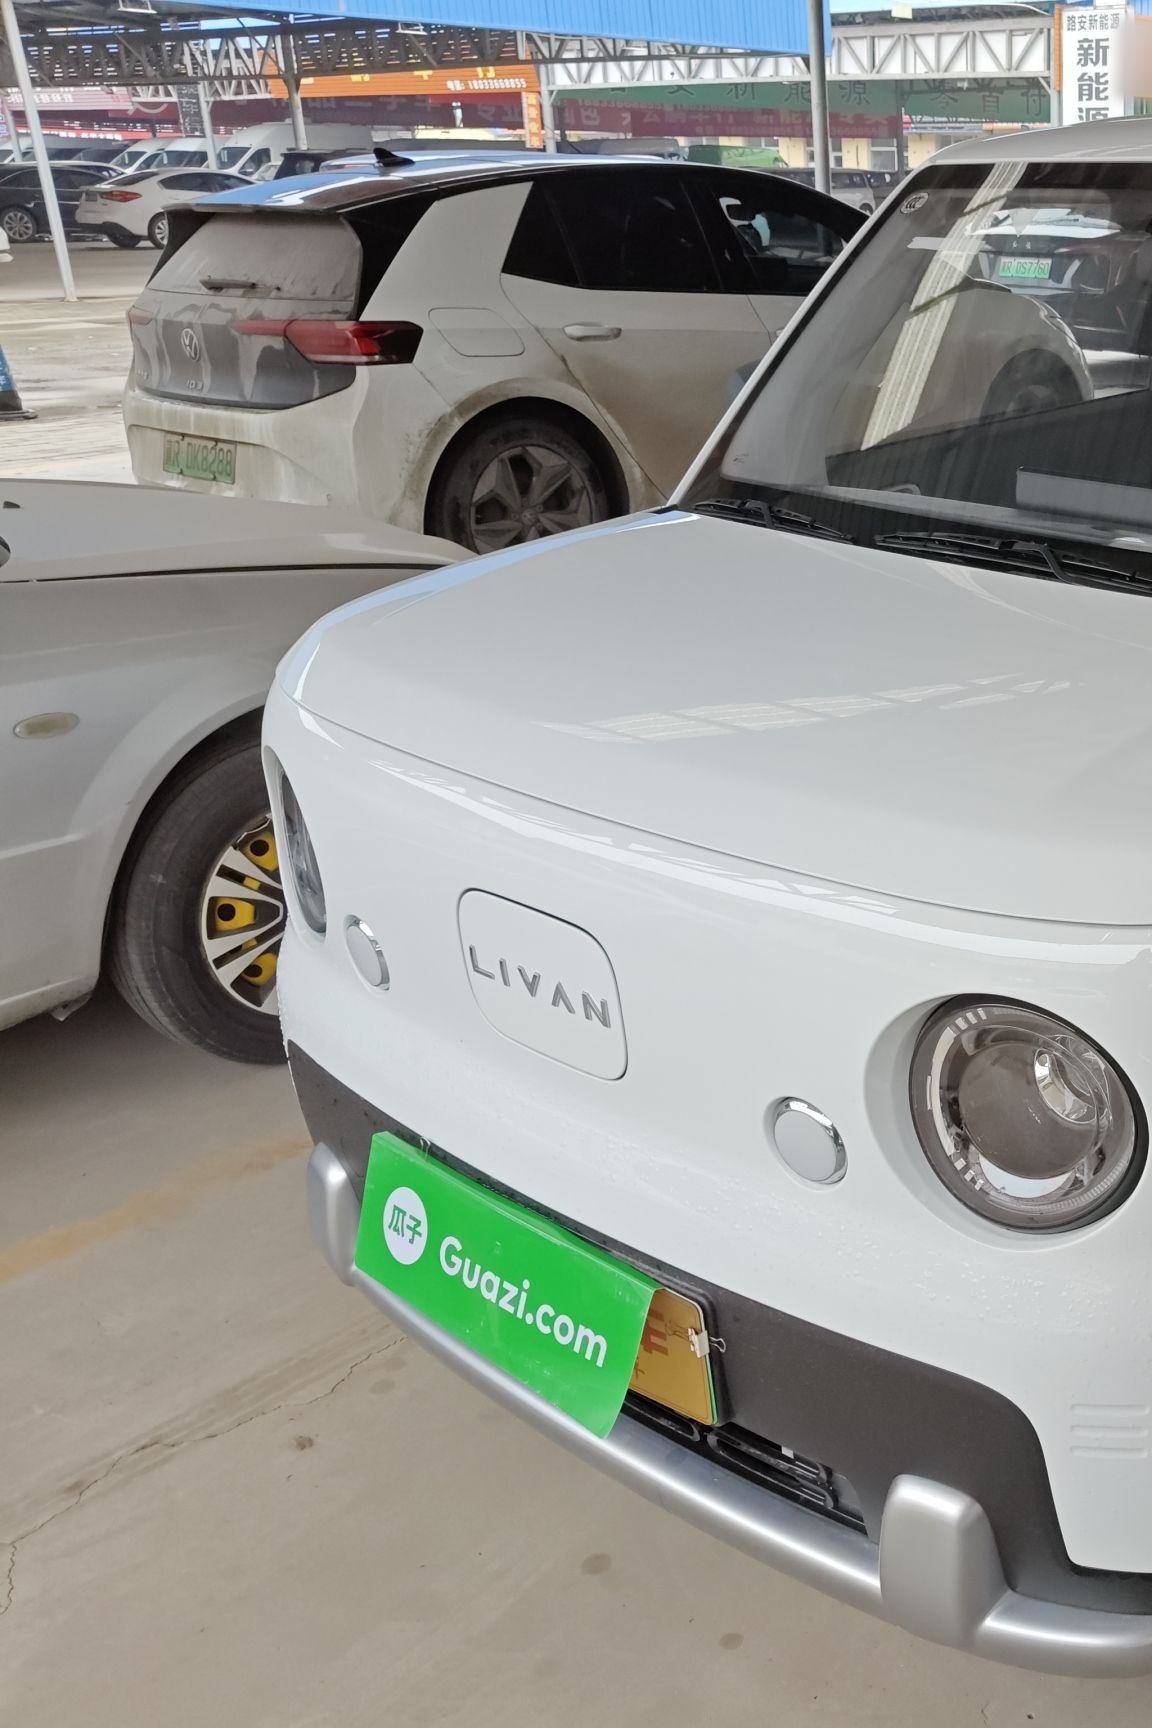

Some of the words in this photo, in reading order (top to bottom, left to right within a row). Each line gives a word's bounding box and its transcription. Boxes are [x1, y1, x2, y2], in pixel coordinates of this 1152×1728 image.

[1066, 13, 1120, 31] 路安新能源
[186, 442, 233, 477] DK8288
[469, 944, 611, 1028] LIVAN
[388, 1204, 423, 1245] 瓜子
[439, 1236, 608, 1368] Guazi.com
